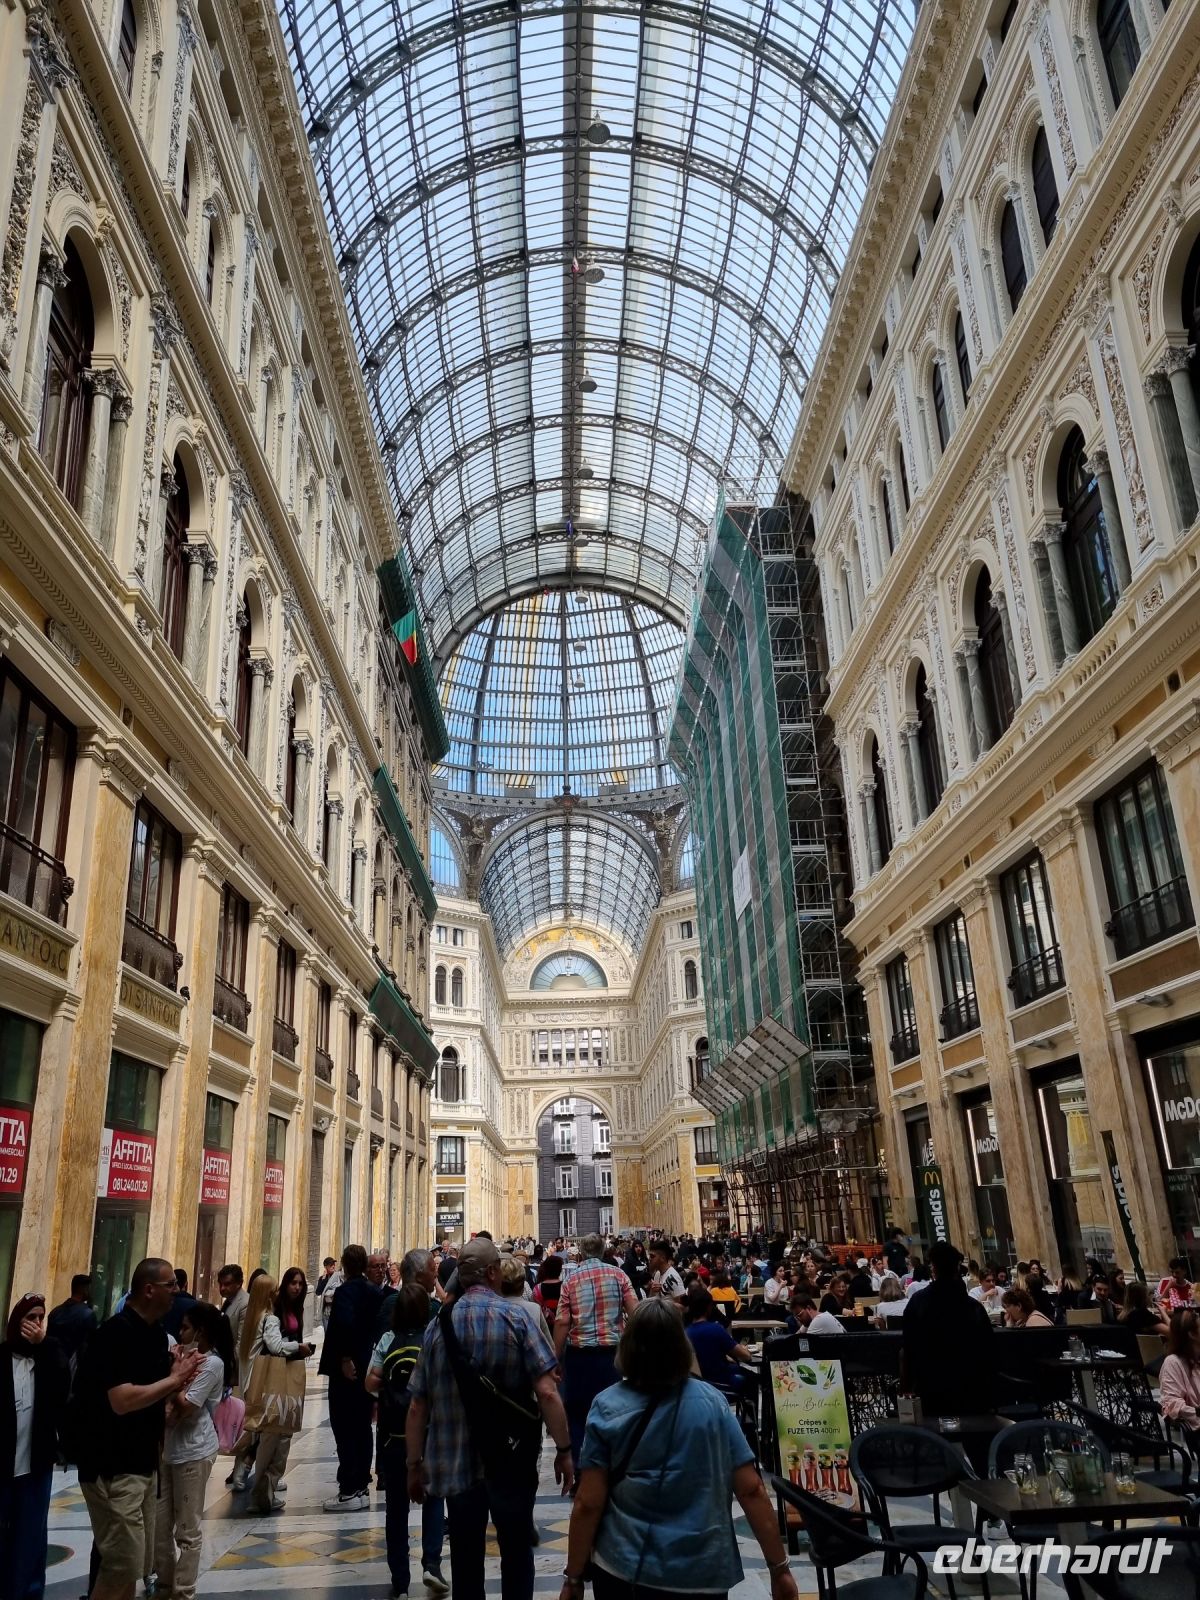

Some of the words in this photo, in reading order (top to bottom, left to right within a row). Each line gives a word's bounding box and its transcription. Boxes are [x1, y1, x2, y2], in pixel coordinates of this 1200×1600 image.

[112, 1138, 152, 1164] AFFITTA
[204, 1156, 230, 1176] AFFITTA
[266, 1168, 284, 1183] AFFITTA
[112, 1178, 148, 1192] 081.240.01.29
[787, 1427, 806, 1435] FUZE
